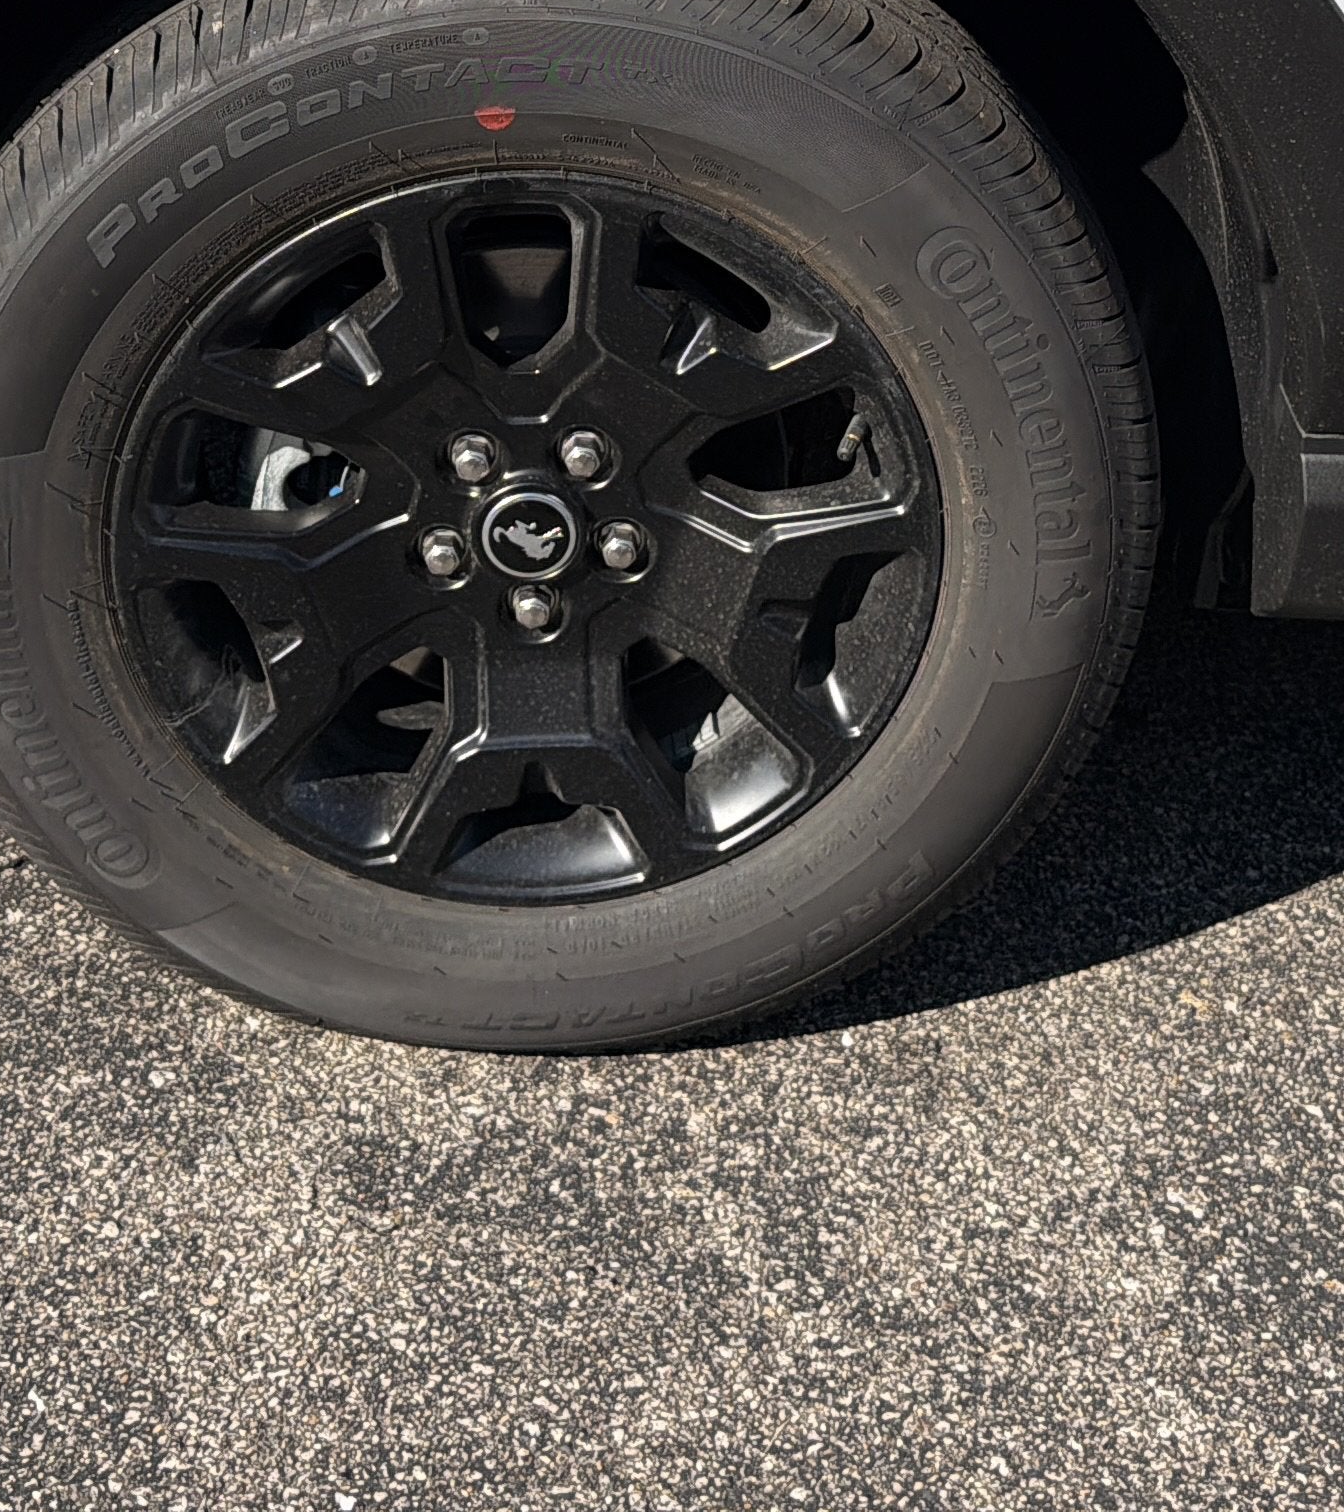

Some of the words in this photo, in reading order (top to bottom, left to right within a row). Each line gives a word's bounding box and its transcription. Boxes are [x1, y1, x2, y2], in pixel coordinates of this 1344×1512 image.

[561, 132, 630, 151] CONTINENTAL
[916, 337, 946, 370] DOT
[915, 226, 1092, 567] Continental
